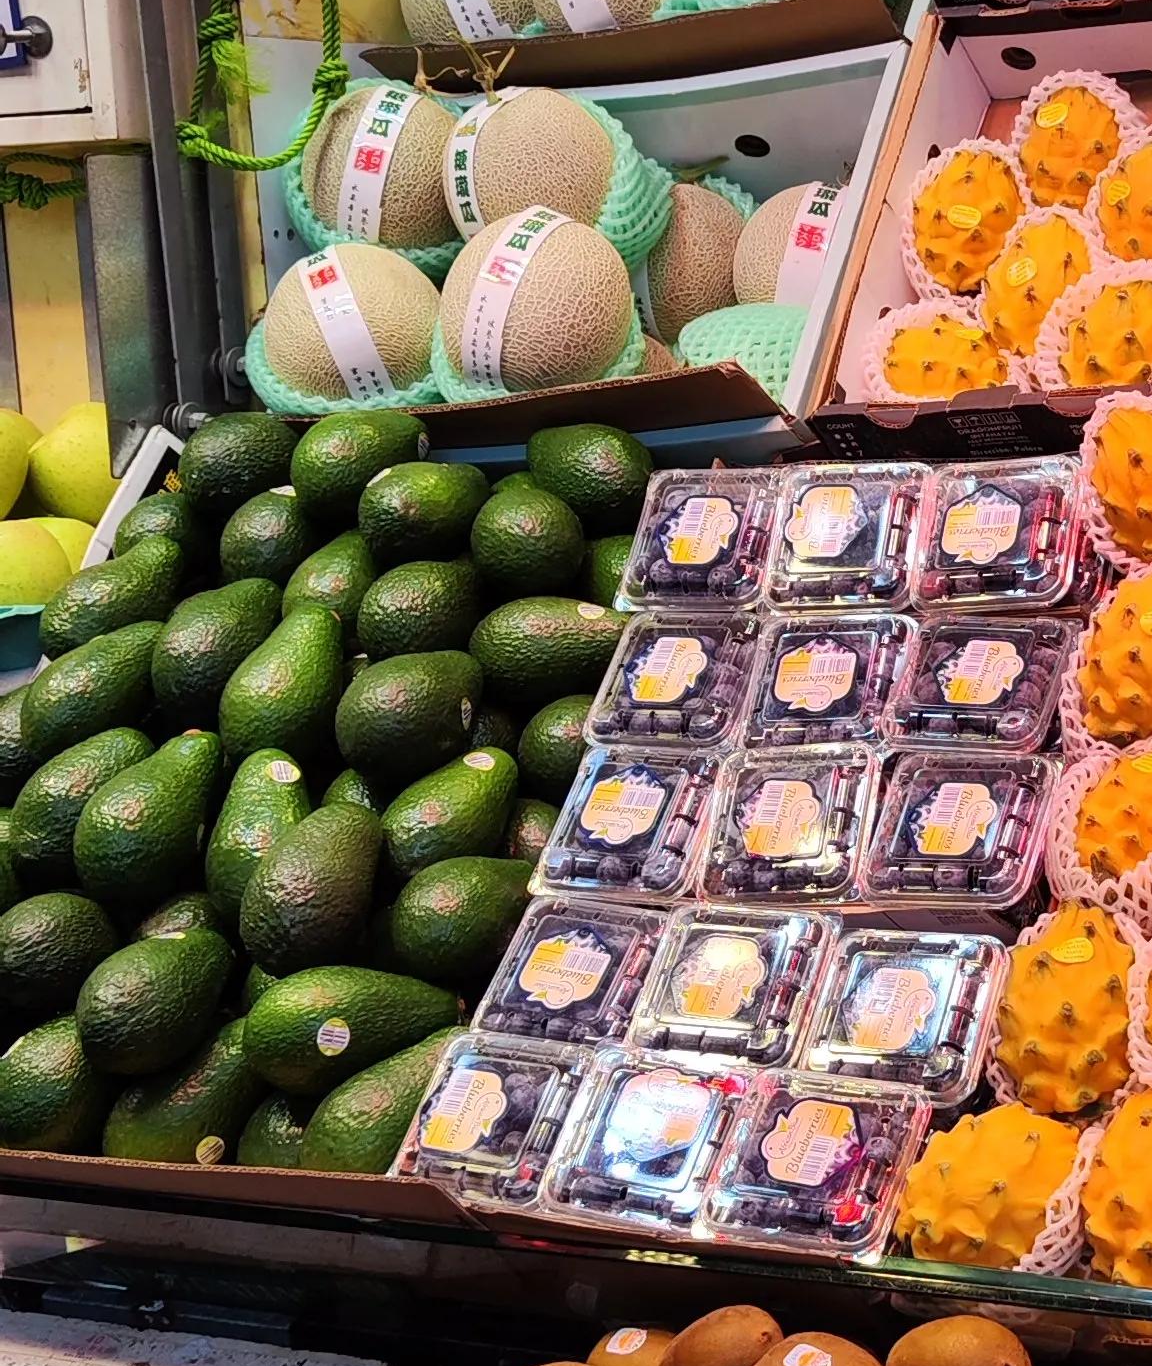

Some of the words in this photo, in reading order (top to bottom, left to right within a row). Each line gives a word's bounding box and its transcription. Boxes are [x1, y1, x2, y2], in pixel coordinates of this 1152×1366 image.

[948, 524, 1010, 537] Blueberries
[655, 643, 687, 697] Blueberries
[781, 673, 845, 686] Blueberries
[970, 644, 1000, 699] Blueberries
[591, 802, 650, 820] Blueberries
[768, 787, 797, 849] Blueberries
[943, 789, 973, 849] Blueberries
[529, 962, 592, 986] Blueberries
[446, 1078, 486, 1144] Blueberries
[784, 1106, 822, 1175] Blueberries
